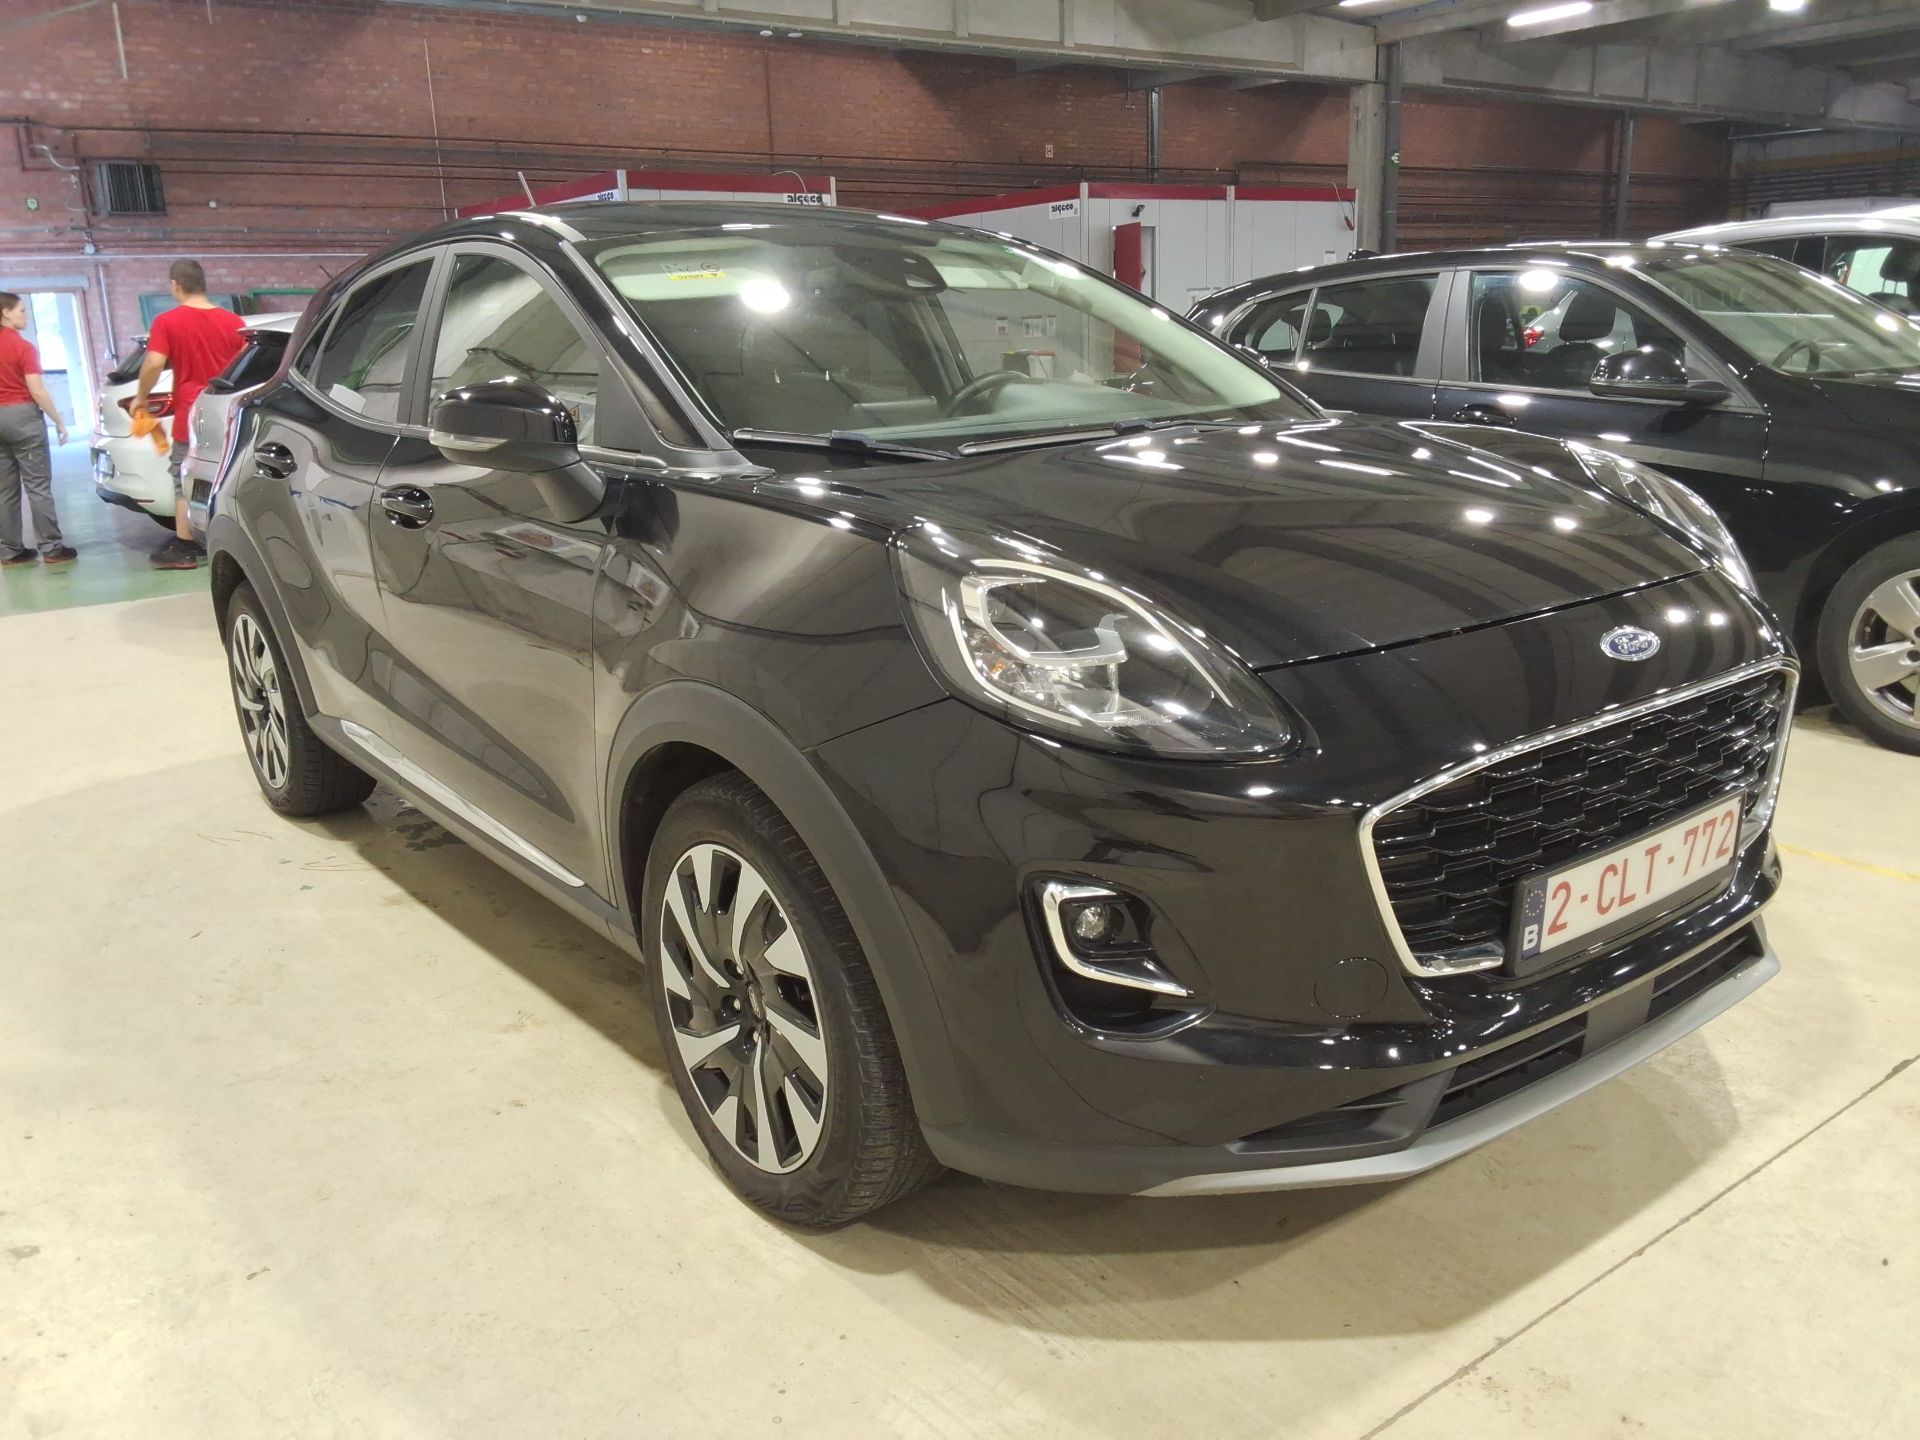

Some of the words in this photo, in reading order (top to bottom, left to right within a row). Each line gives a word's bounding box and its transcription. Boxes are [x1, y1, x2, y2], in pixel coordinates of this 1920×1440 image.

[1613, 633, 1650, 655] Ford
[1547, 809, 1735, 937] 2-CLT-772
[1522, 923, 1540, 952] B
